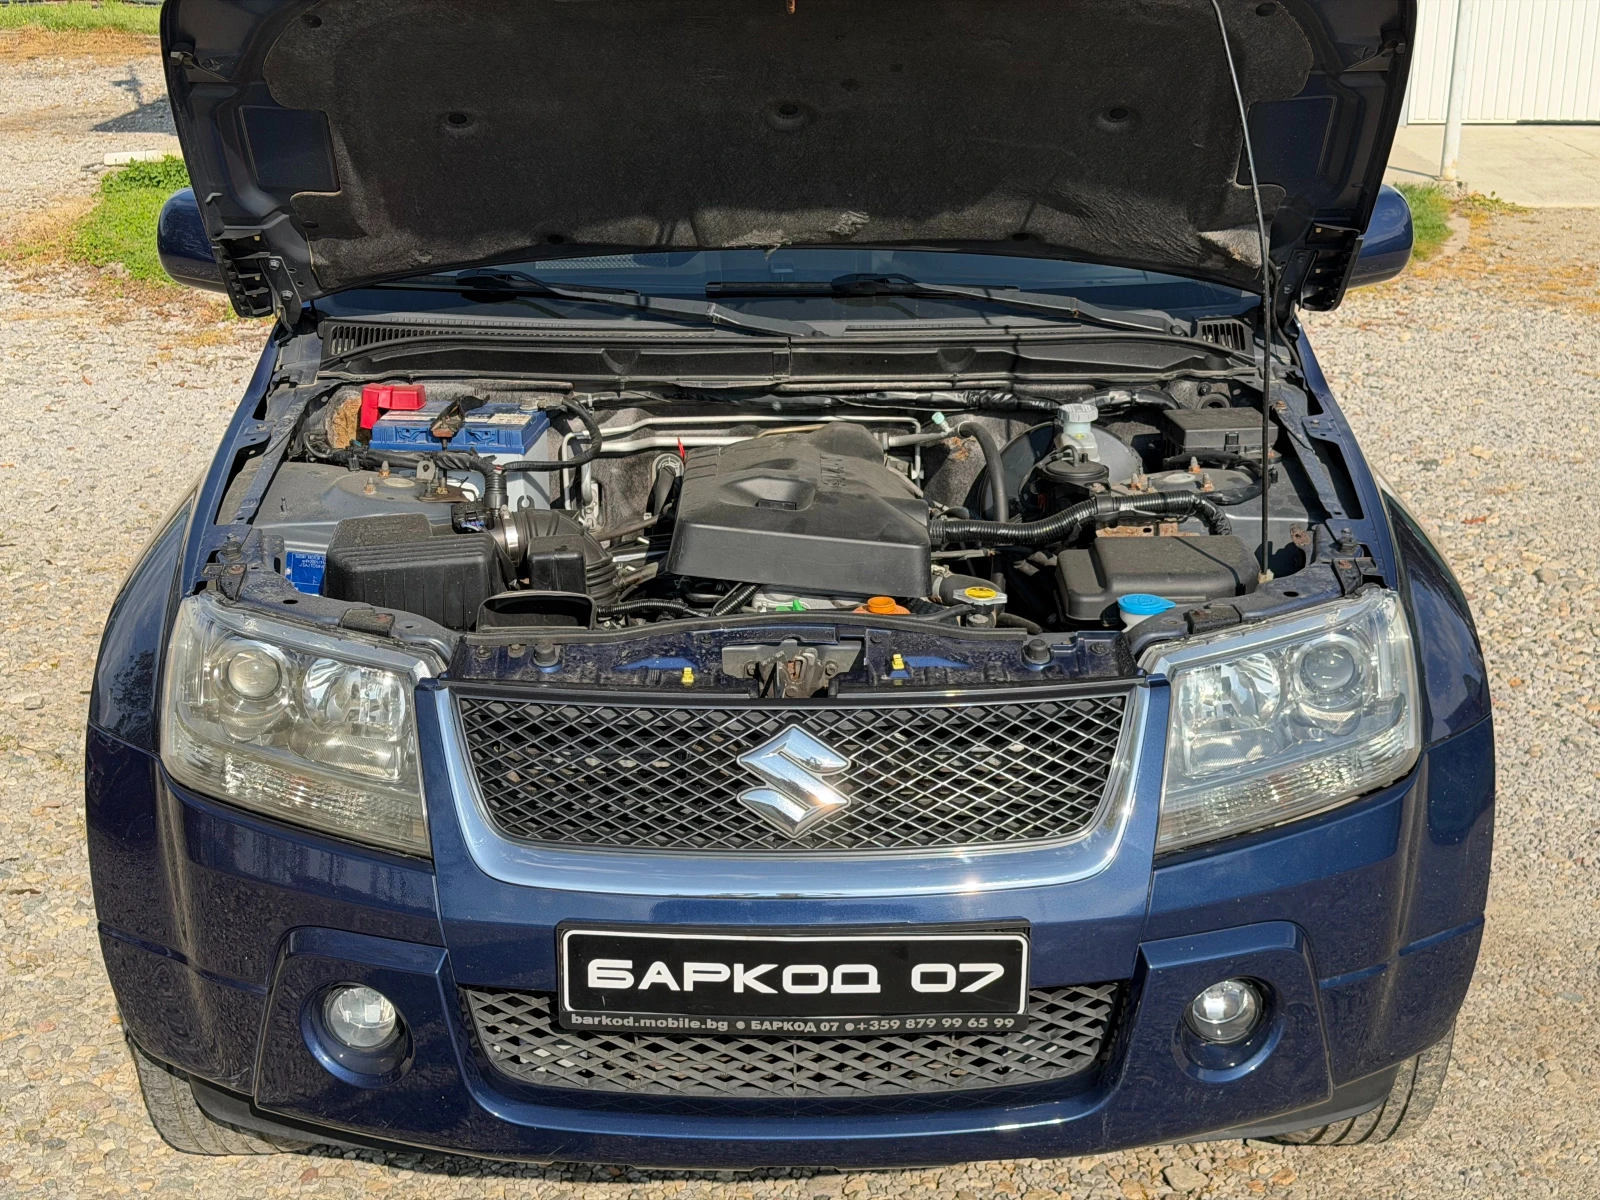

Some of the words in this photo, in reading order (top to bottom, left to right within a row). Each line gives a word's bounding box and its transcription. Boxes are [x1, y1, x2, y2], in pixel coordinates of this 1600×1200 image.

[587, 958, 881, 994] БАРКОД
[911, 963, 1005, 993] 07
[571, 1013, 729, 1032] barkod.mobile.bg
[750, 1020, 817, 1033] БАРКОД
[819, 1021, 840, 1032] 07
[856, 1019, 901, 1031] +359
[905, 1018, 937, 1029] 879
[941, 1017, 963, 1028] 99
[967, 1017, 989, 1028] 65
[993, 1017, 1015, 1028] 99
